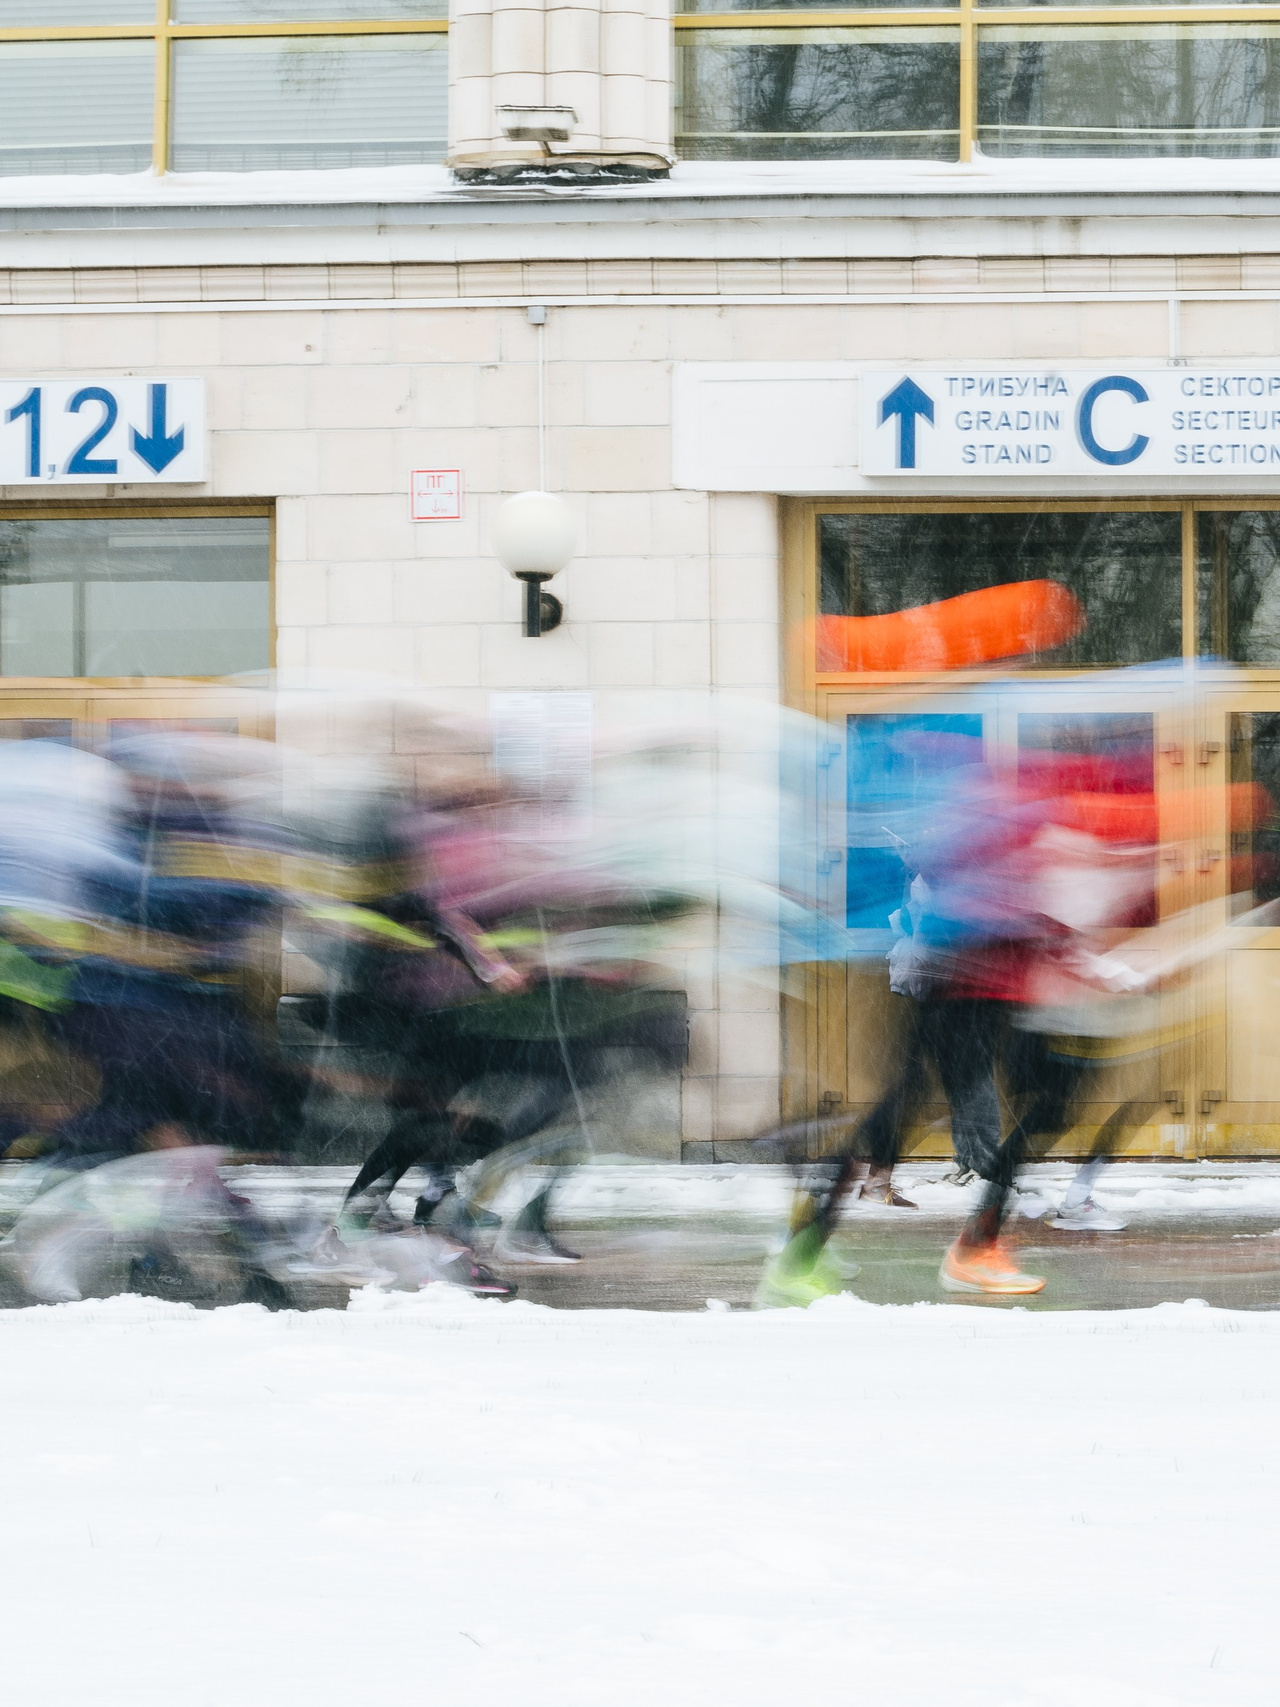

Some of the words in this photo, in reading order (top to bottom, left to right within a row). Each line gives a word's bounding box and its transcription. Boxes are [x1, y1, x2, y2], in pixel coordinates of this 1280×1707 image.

[944, 377, 1069, 397] ТРИБУНА
[955, 410, 1060, 431] GRADIN
[4, 386, 119, 480] 1,2
[961, 444, 1053, 464] STAND
